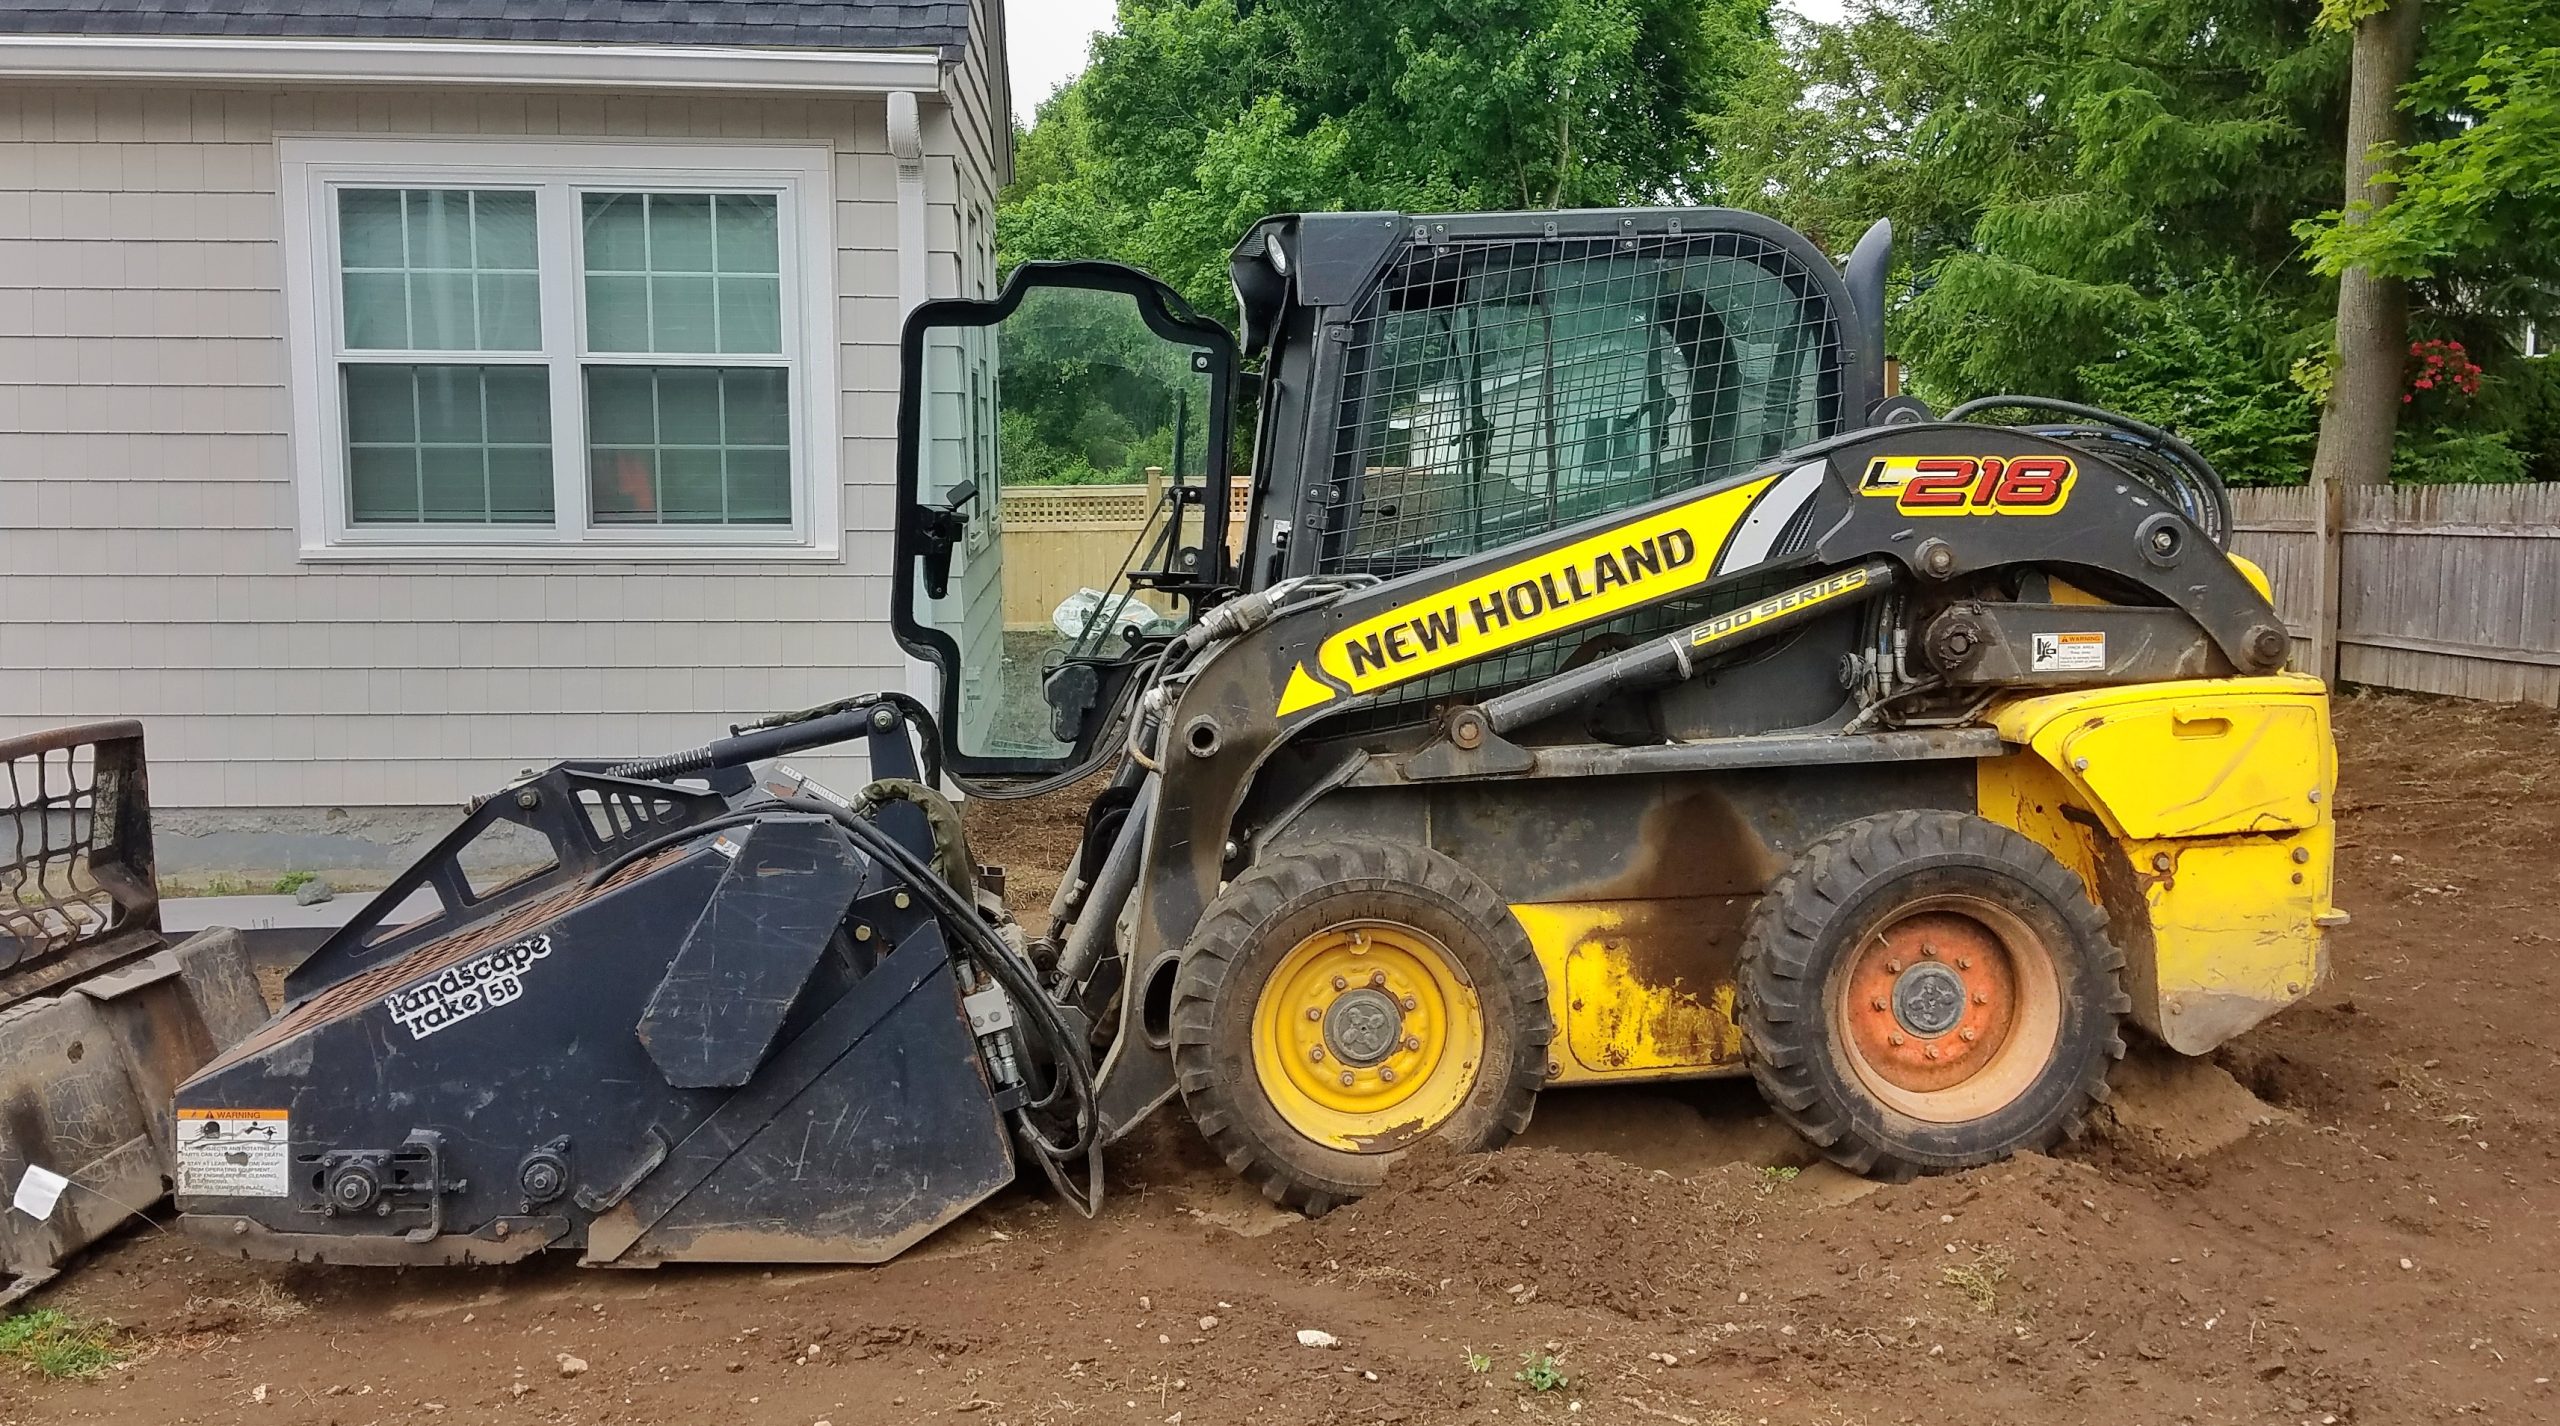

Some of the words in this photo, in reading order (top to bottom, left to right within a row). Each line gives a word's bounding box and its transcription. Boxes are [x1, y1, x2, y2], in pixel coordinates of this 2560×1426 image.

[1861, 459, 2071, 507] L218
[1345, 604, 1461, 678] NEW
[1469, 527, 1695, 635] HOLLAND
[1691, 611, 1752, 643] 200
[1754, 569, 1868, 617] SERIES
[389, 936, 547, 1018] landscape
[411, 993, 478, 1034] rake
[489, 978, 519, 1002] 5B
